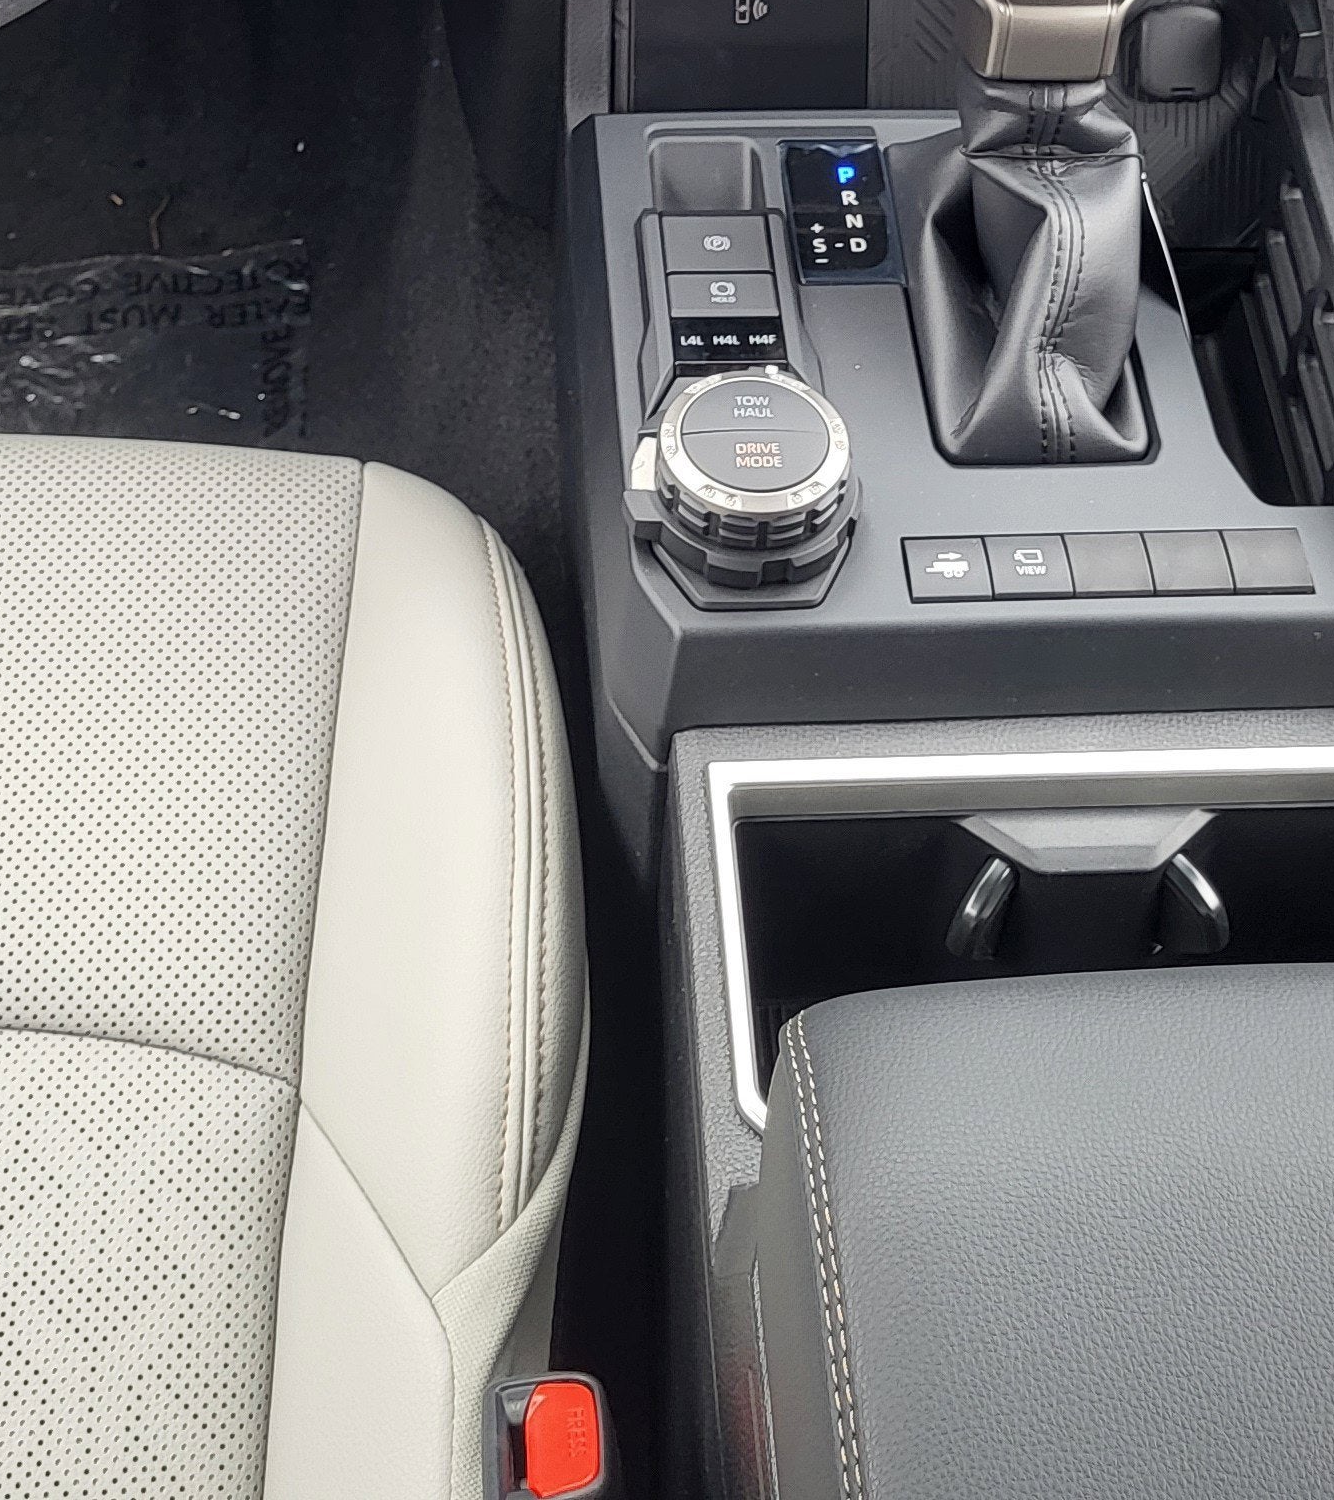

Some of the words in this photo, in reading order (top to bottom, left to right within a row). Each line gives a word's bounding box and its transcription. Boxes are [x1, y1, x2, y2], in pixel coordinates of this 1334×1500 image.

[837, 166, 855, 183] P
[841, 190, 859, 206] R
[845, 213, 864, 229] N
[812, 237, 828, 253] S
[849, 238, 867, 253] D
[680, 334, 704, 346] L4L
[713, 334, 740, 346] H4L
[749, 334, 777, 346] H4F
[734, 395, 770, 407] TOW
[733, 407, 775, 419] HAUL
[735, 442, 781, 455] DRIVE
[735, 455, 784, 468] MODE
[1015, 564, 1047, 576] VIEW
